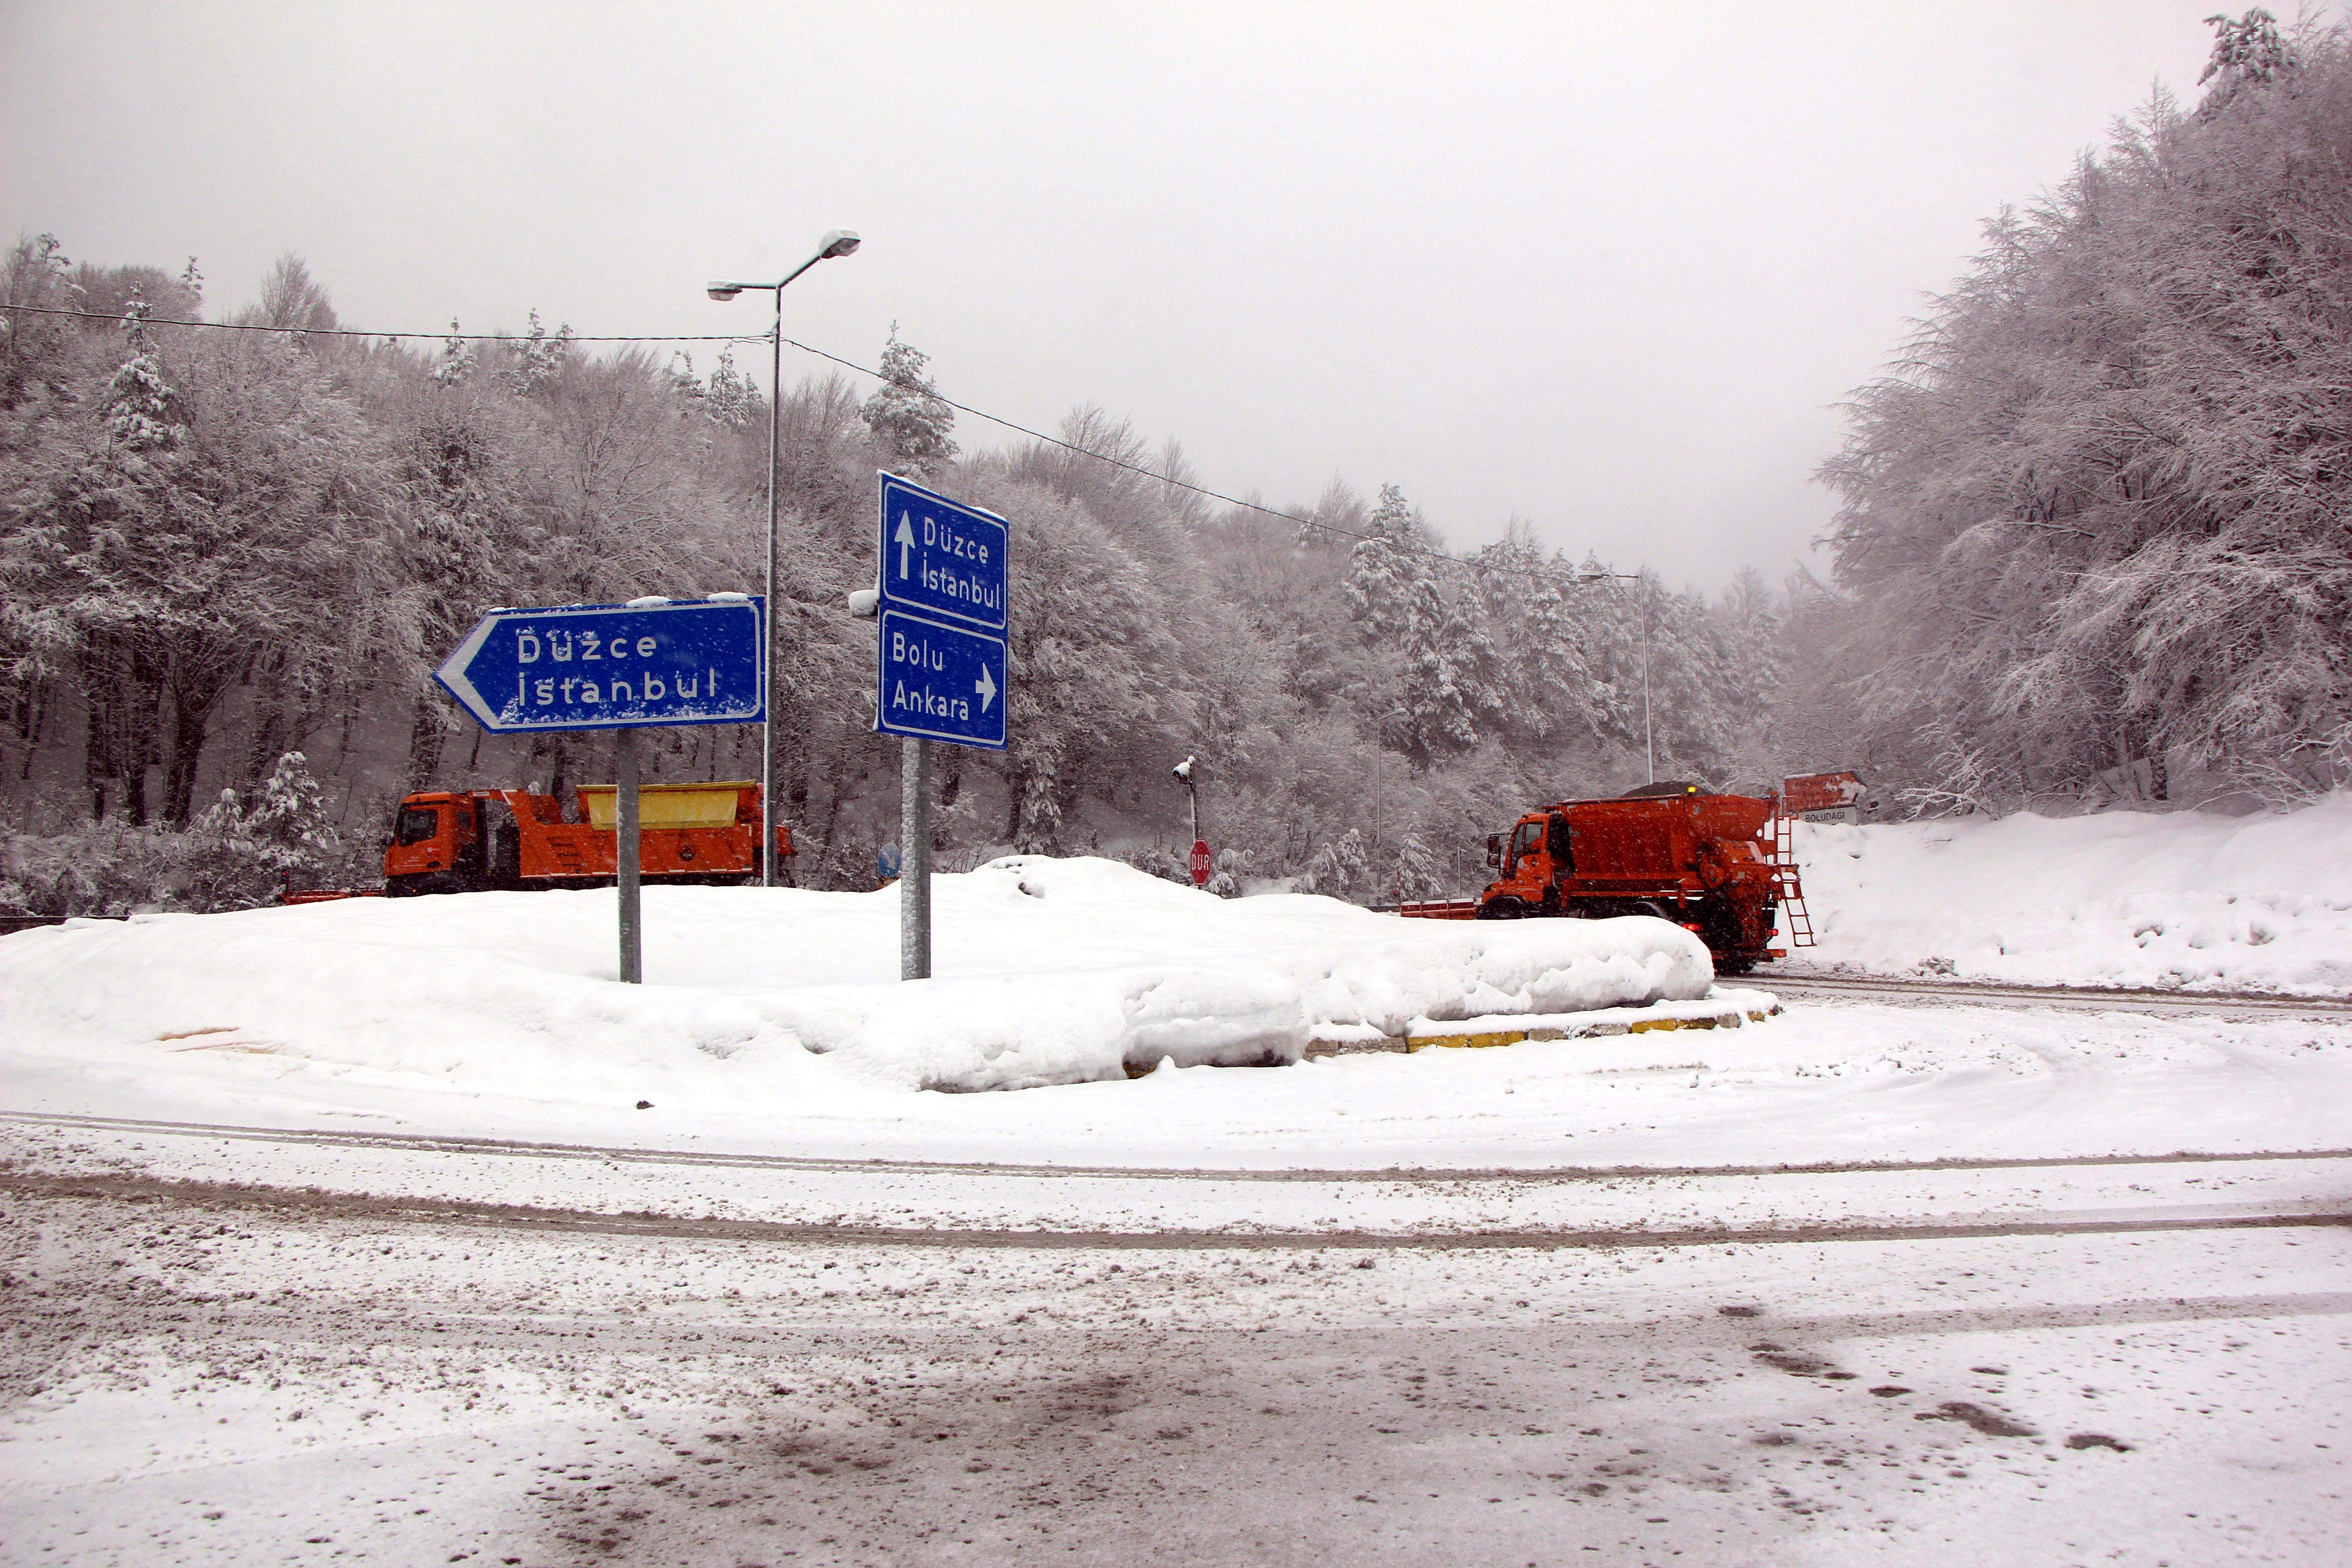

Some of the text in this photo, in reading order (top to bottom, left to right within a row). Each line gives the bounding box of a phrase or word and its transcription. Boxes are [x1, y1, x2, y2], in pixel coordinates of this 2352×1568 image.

[924, 516, 988, 564] Düzce
[923, 551, 1000, 610] İstanbul
[518, 635, 657, 663] Düzce
[892, 632, 943, 671] Bolu
[519, 667, 715, 706] İstanbul
[892, 680, 969, 720] Ankara
[1191, 854, 1210, 871] DUR
